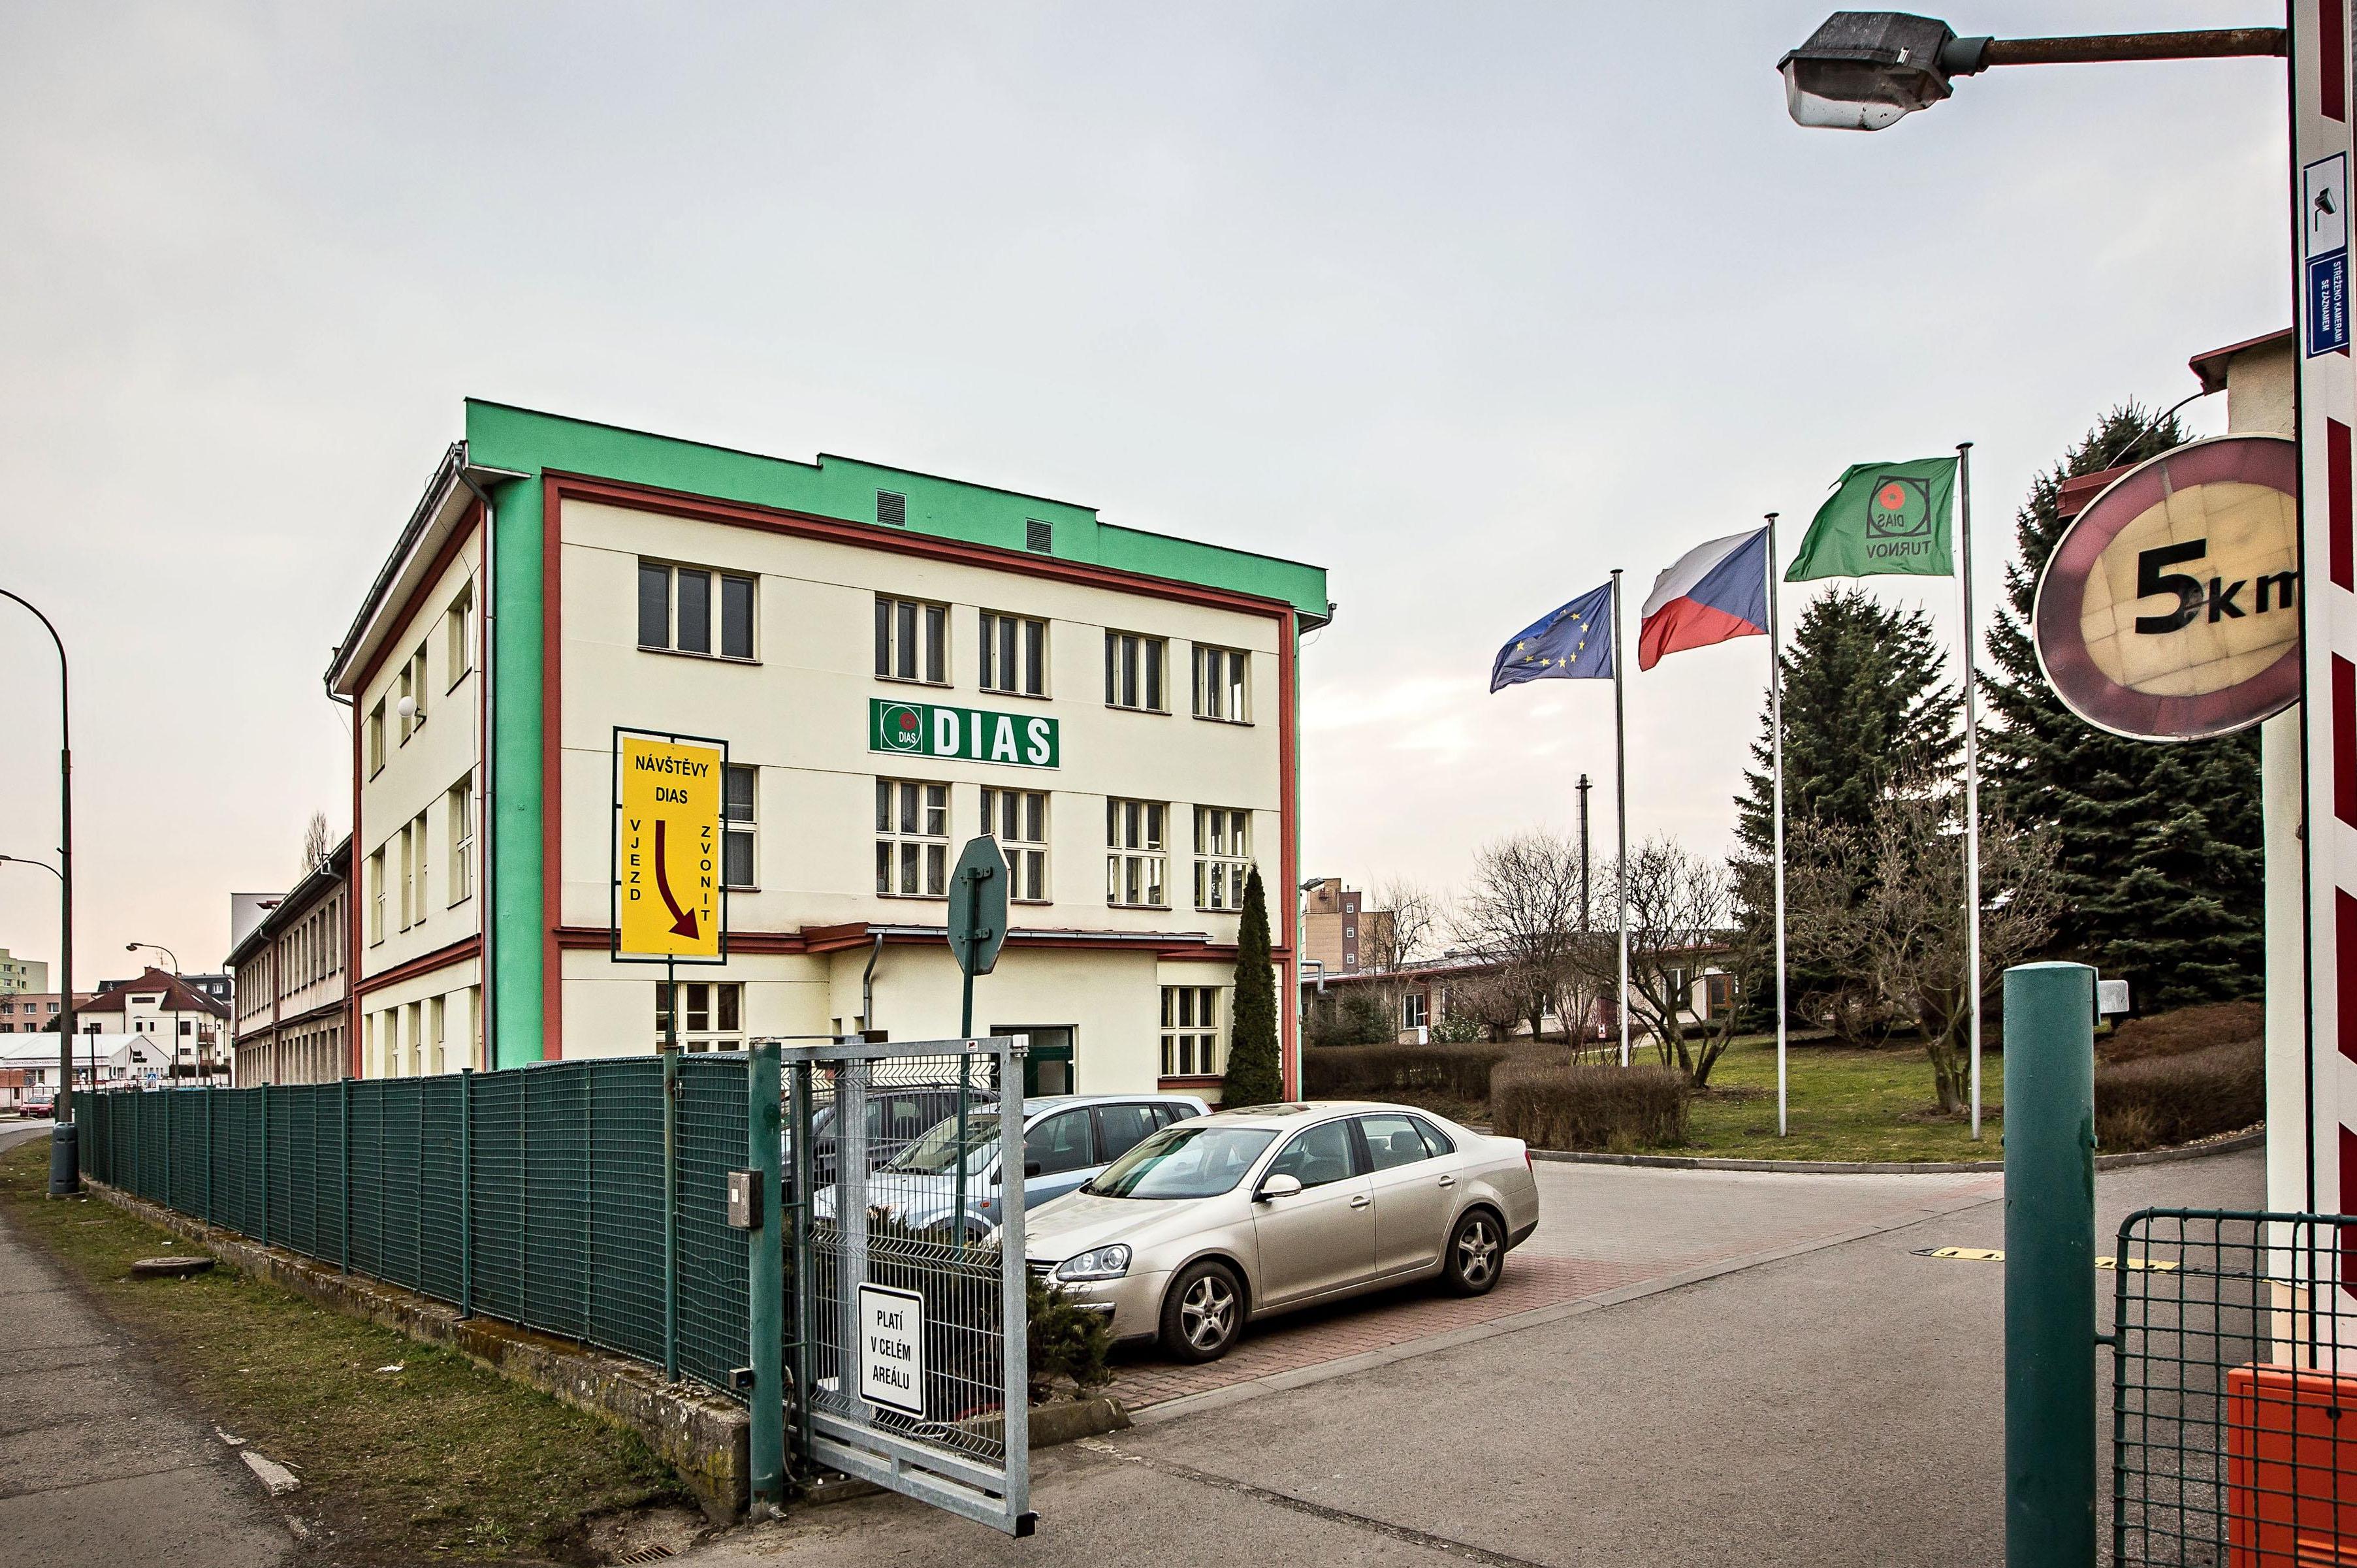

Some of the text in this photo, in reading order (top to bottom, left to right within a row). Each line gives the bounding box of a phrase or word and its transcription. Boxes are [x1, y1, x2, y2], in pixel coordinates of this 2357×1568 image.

[2321, 279, 2329, 290] SE
[2333, 261, 2343, 300] STŘEŽENO
[899, 731, 916, 744] DIAS
[933, 708, 1050, 765] DIAS
[635, 754, 709, 778] NÁVŠTĚVY
[656, 786, 688, 805] DIAS
[630, 819, 641, 901] VJEZD
[700, 825, 712, 921] ZVONIT
[877, 1310, 903, 1331] PLATÍ
[871, 1336, 911, 1362] V CELÉM
[873, 1365, 910, 1390] AREÁLU
